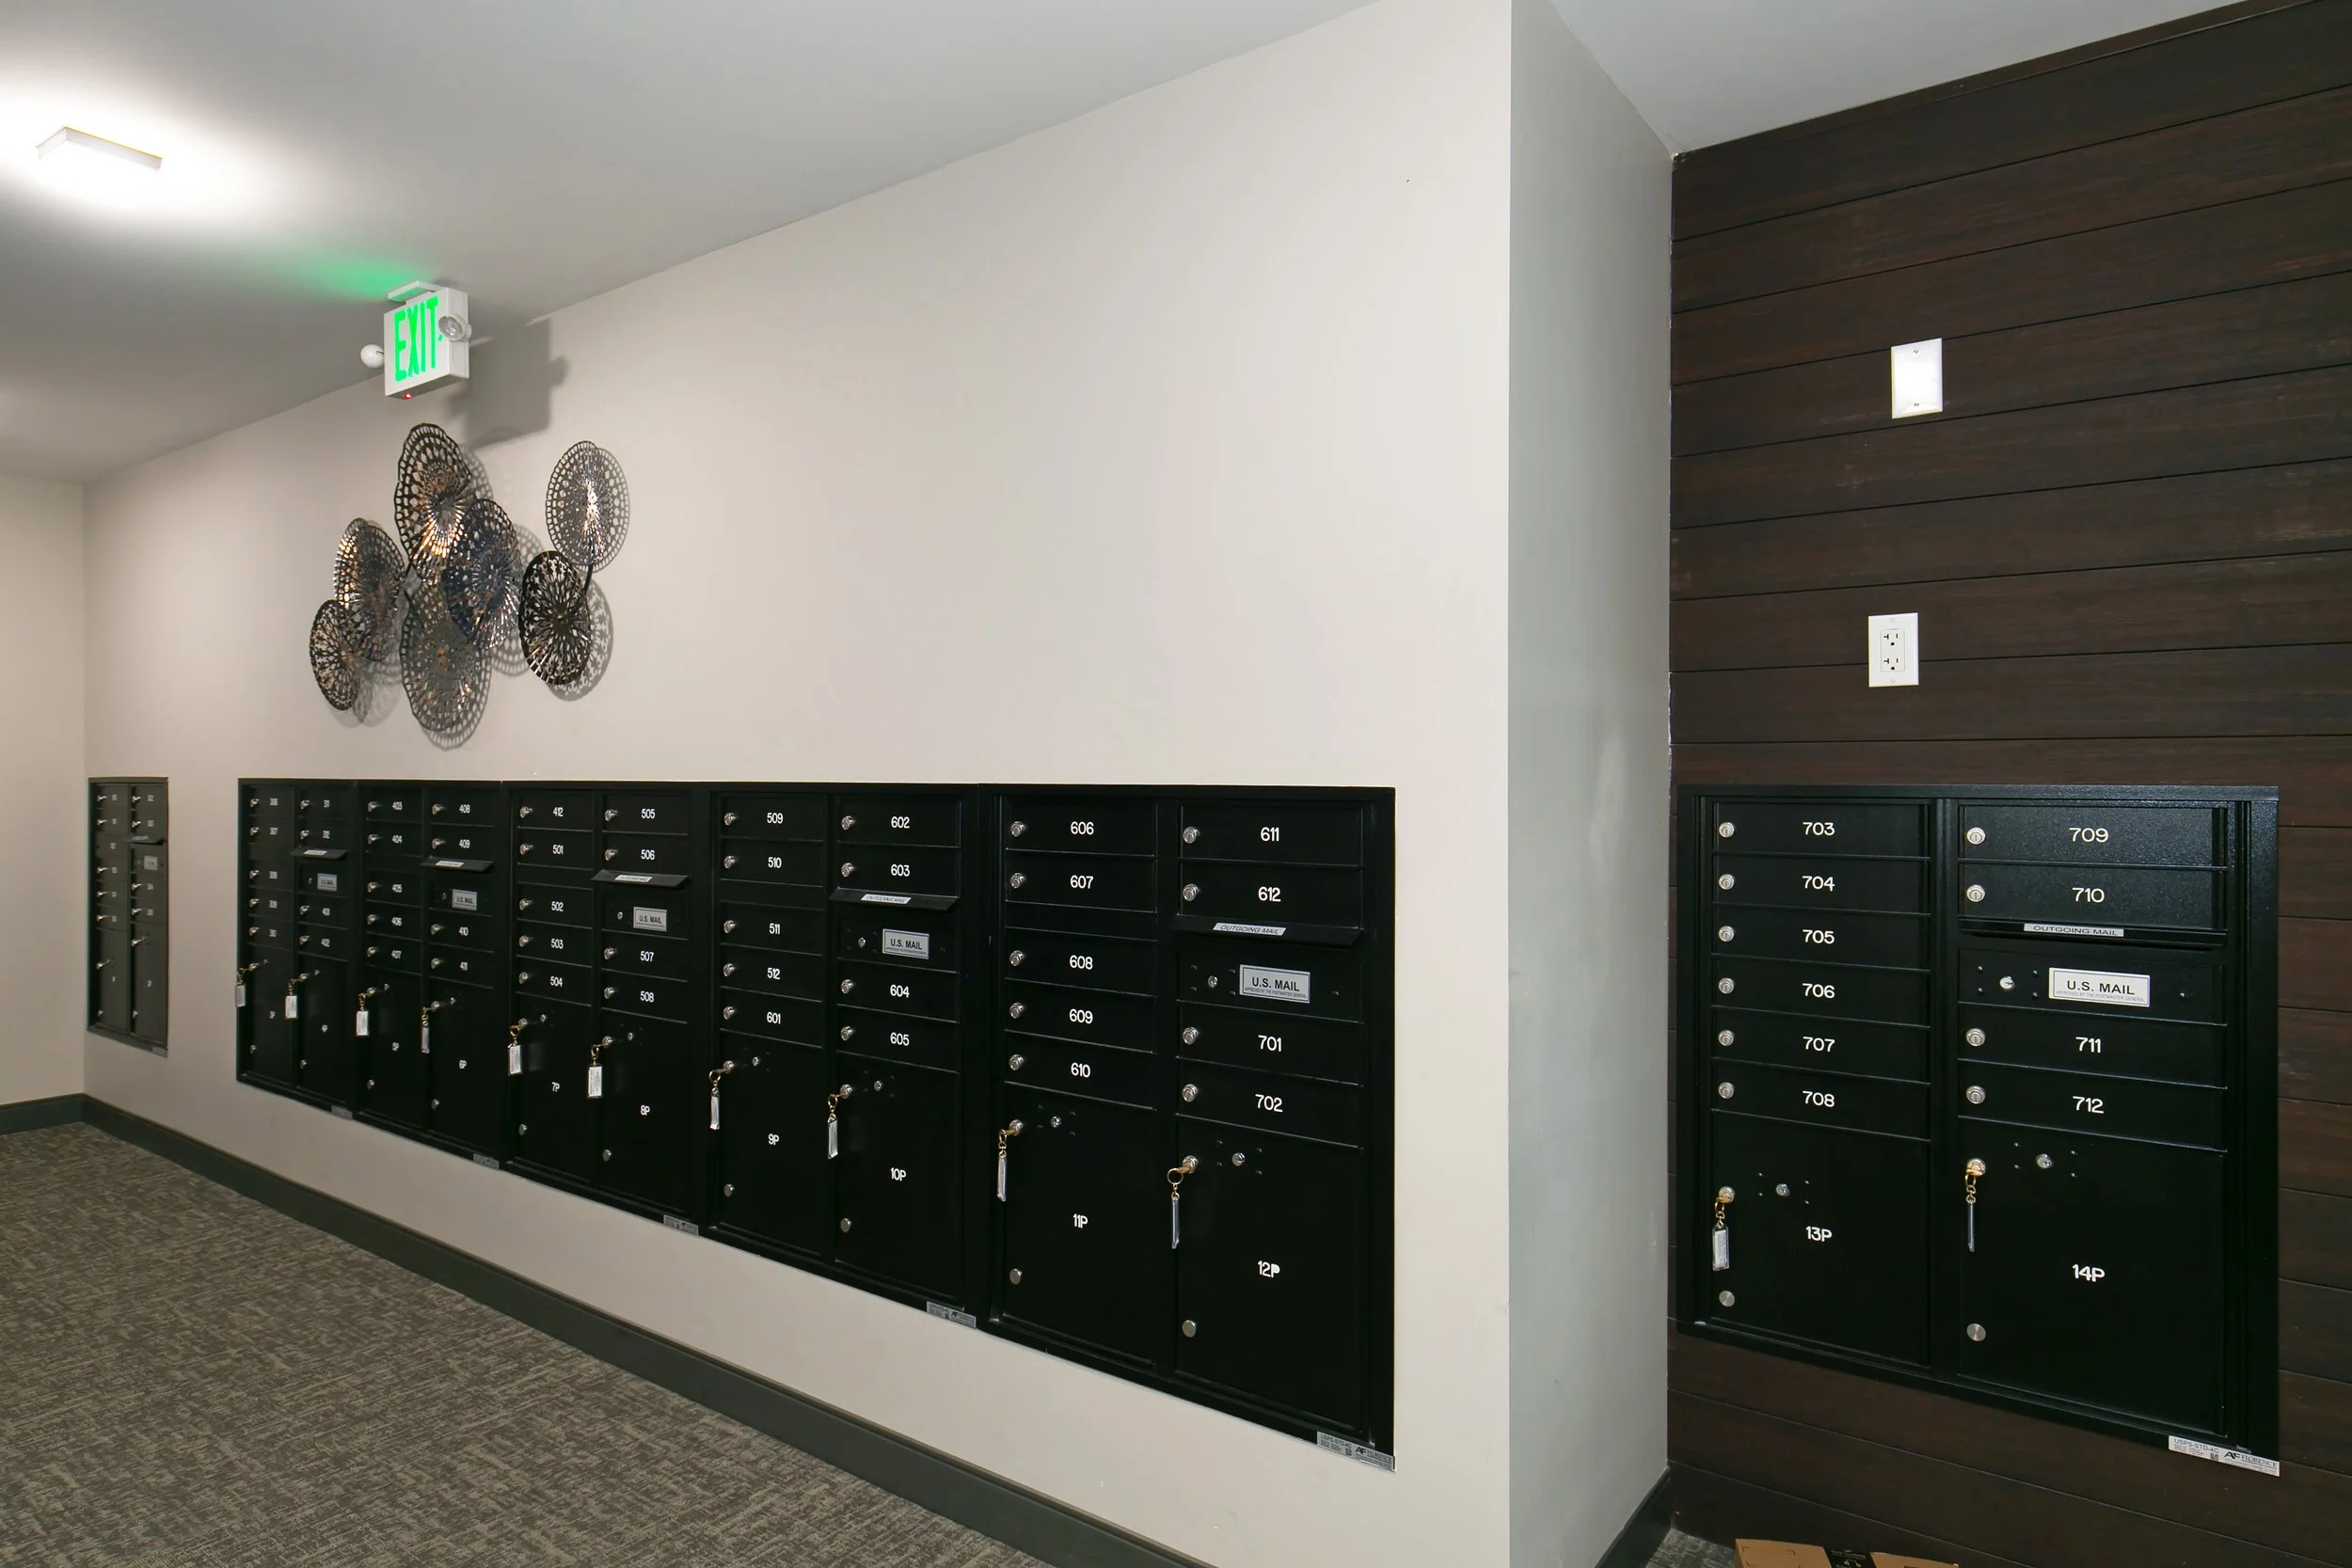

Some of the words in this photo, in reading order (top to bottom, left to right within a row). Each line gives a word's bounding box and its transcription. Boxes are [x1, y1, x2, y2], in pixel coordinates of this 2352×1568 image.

[394, 295, 439, 382] EXIT
[391, 801, 403, 811] 403
[459, 804, 470, 814] 408
[552, 806, 564, 817] 412
[641, 808, 656, 819] 505
[767, 812, 784, 824] 509
[890, 816, 911, 829] 602
[1070, 820, 1094, 835] 606
[1260, 826, 1279, 842] 611
[1802, 821, 1836, 836] 703
[2068, 827, 2109, 843] 709
[391, 834, 403, 844] 404
[458, 839, 470, 849] 409
[552, 844, 564, 855] 501
[640, 848, 656, 861] 506
[768, 856, 783, 869] 510
[890, 863, 911, 878] 603
[1070, 874, 1094, 890] 607
[1802, 875, 1836, 892] 704
[1258, 886, 1281, 902] 612
[2072, 887, 2106, 903] 710
[550, 900, 564, 912] 502
[458, 927, 469, 937] 410
[769, 923, 781, 935] 511
[1220, 925, 1262, 933] OUTGOING
[1802, 928, 1836, 944] 705
[2033, 925, 2090, 934] OUTGOING
[550, 938, 564, 950] 503
[890, 938, 904, 947] U.S.
[905, 941, 923, 950] MAIL
[640, 950, 655, 962] 507
[1069, 954, 1093, 971] 608
[767, 967, 781, 980] 512
[549, 975, 564, 988] 504
[1251, 976, 1272, 988] U.S.
[1274, 979, 1300, 992] MAIL
[2066, 980, 2094, 992] U.S.
[2099, 983, 2136, 995] MAIL
[640, 990, 655, 1003] 508
[889, 984, 911, 998] 604
[1802, 982, 1836, 999] 706
[766, 1011, 781, 1024] 601
[1069, 1008, 1093, 1024] 609
[890, 1032, 910, 1047] 605
[1258, 1035, 1282, 1053] 701
[1803, 1036, 1836, 1053] 707
[2075, 1037, 2102, 1053] 711
[1071, 1062, 1091, 1078] 610
[1255, 1093, 1283, 1113] 702
[1802, 1090, 1836, 1108] 708
[2072, 1095, 2105, 1115] 712
[640, 1104, 651, 1117] 8P
[768, 1132, 780, 1146] 9P
[890, 1166, 907, 1181] 10P
[1073, 1212, 1089, 1229] 11P
[1805, 1226, 1833, 1243] 13P
[1257, 1259, 1280, 1278] 12P
[2072, 1263, 2106, 1283] 14P
[2173, 1437, 2219, 1454] USPS-STD-4C
